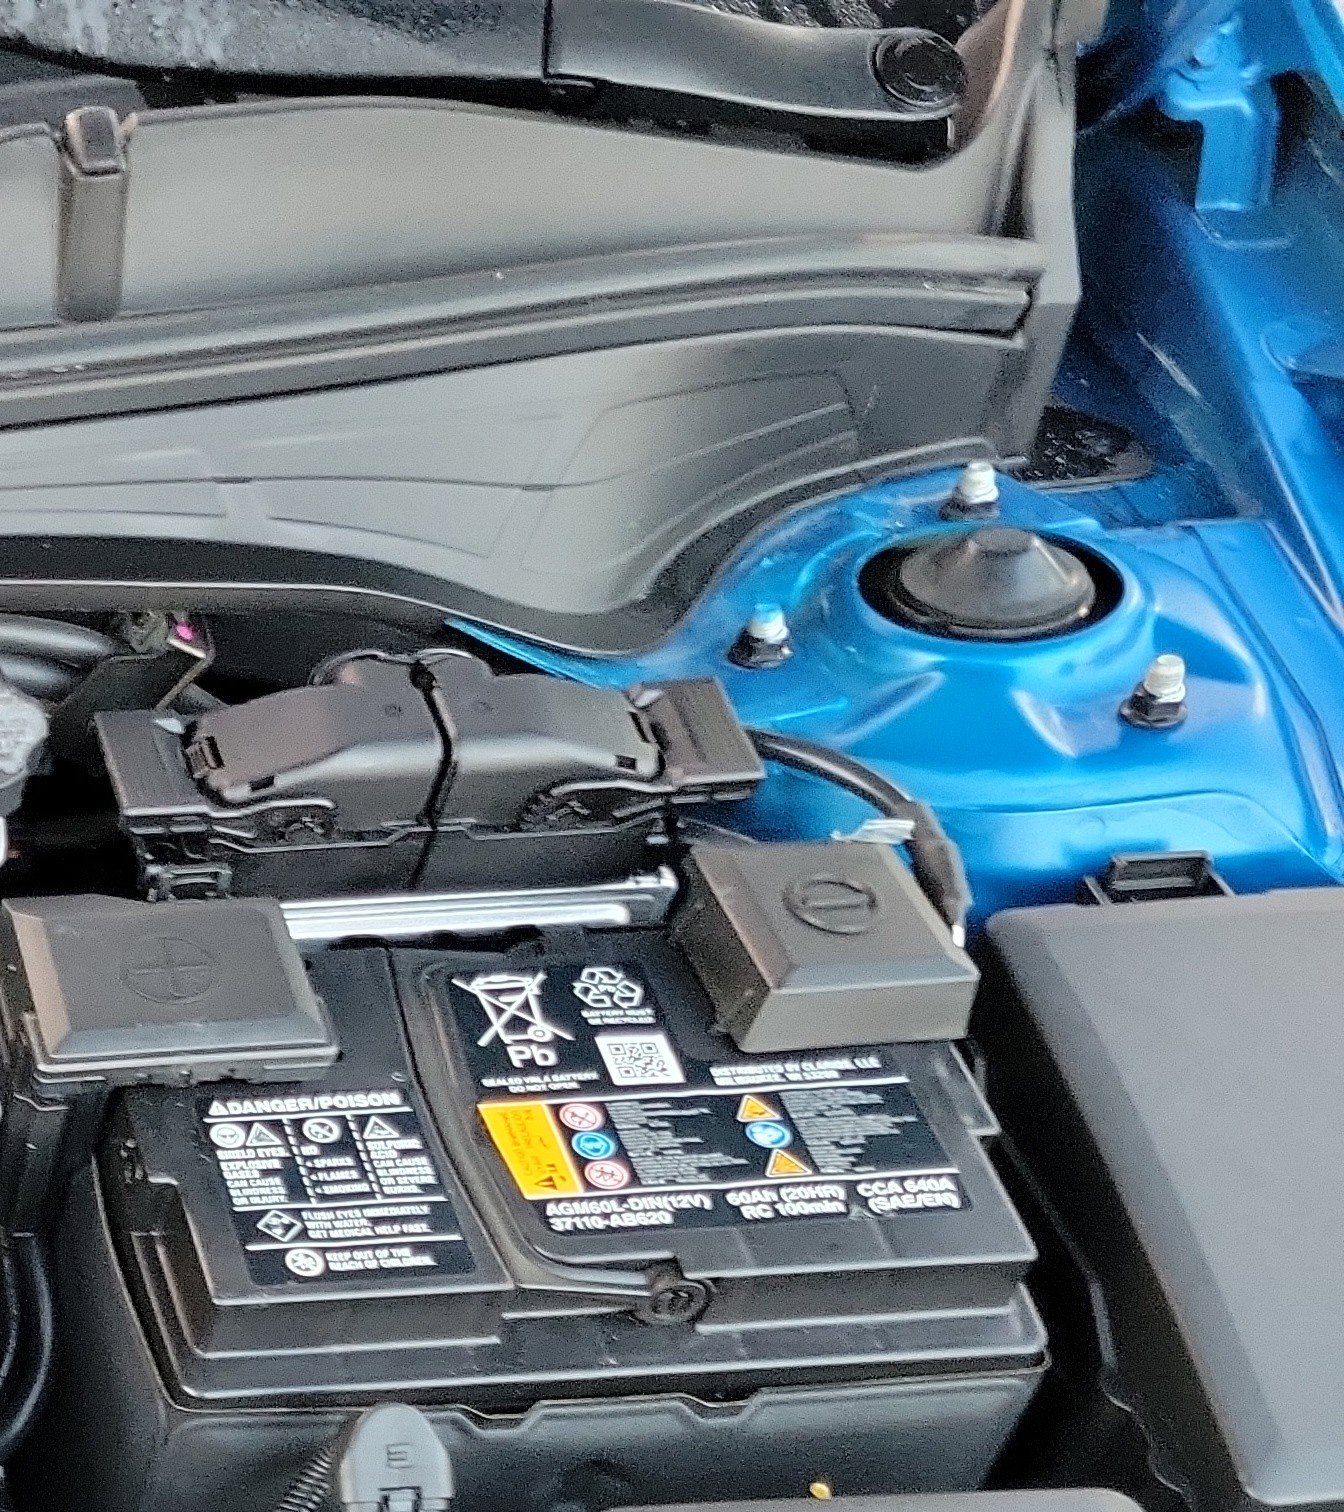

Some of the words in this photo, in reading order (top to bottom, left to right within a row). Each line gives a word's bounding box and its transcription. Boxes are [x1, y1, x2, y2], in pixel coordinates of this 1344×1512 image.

[507, 1044, 559, 1068] Pb
[481, 1077, 524, 1088] SEALED
[550, 1070, 600, 1082] BATTERY
[508, 1085, 526, 1094] DO
[524, 1083, 548, 1093] NOT
[547, 1081, 581, 1090] OPEN
[226, 1091, 402, 1115] DANGER/POISON
[724, 1189, 780, 1208] 60Ah
[778, 1182, 848, 1203] (20HR)
[856, 1178, 903, 1197] CCA
[902, 1174, 958, 1195] 640A
[301, 1209, 336, 1221] FLUSH
[334, 1207, 363, 1220] EYES
[361, 1204, 432, 1218] IMMEDIATELY
[544, 1192, 714, 1219] AGM60L-DIN(12V)
[739, 1203, 775, 1220] RC
[772, 1199, 848, 1217] 100min
[866, 1192, 962, 1214] (SAE/EN)
[304, 1220, 333, 1231] WITH
[307, 1228, 329, 1240] GET
[328, 1226, 378, 1239] MEDICAL
[373, 1223, 403, 1236] HELP
[548, 1210, 675, 1233] 37110-AB620
[324, 1251, 353, 1263] KEEP
[351, 1249, 375, 1261] OUT
[373, 1248, 391, 1260] OF
[388, 1246, 412, 1259] THE
